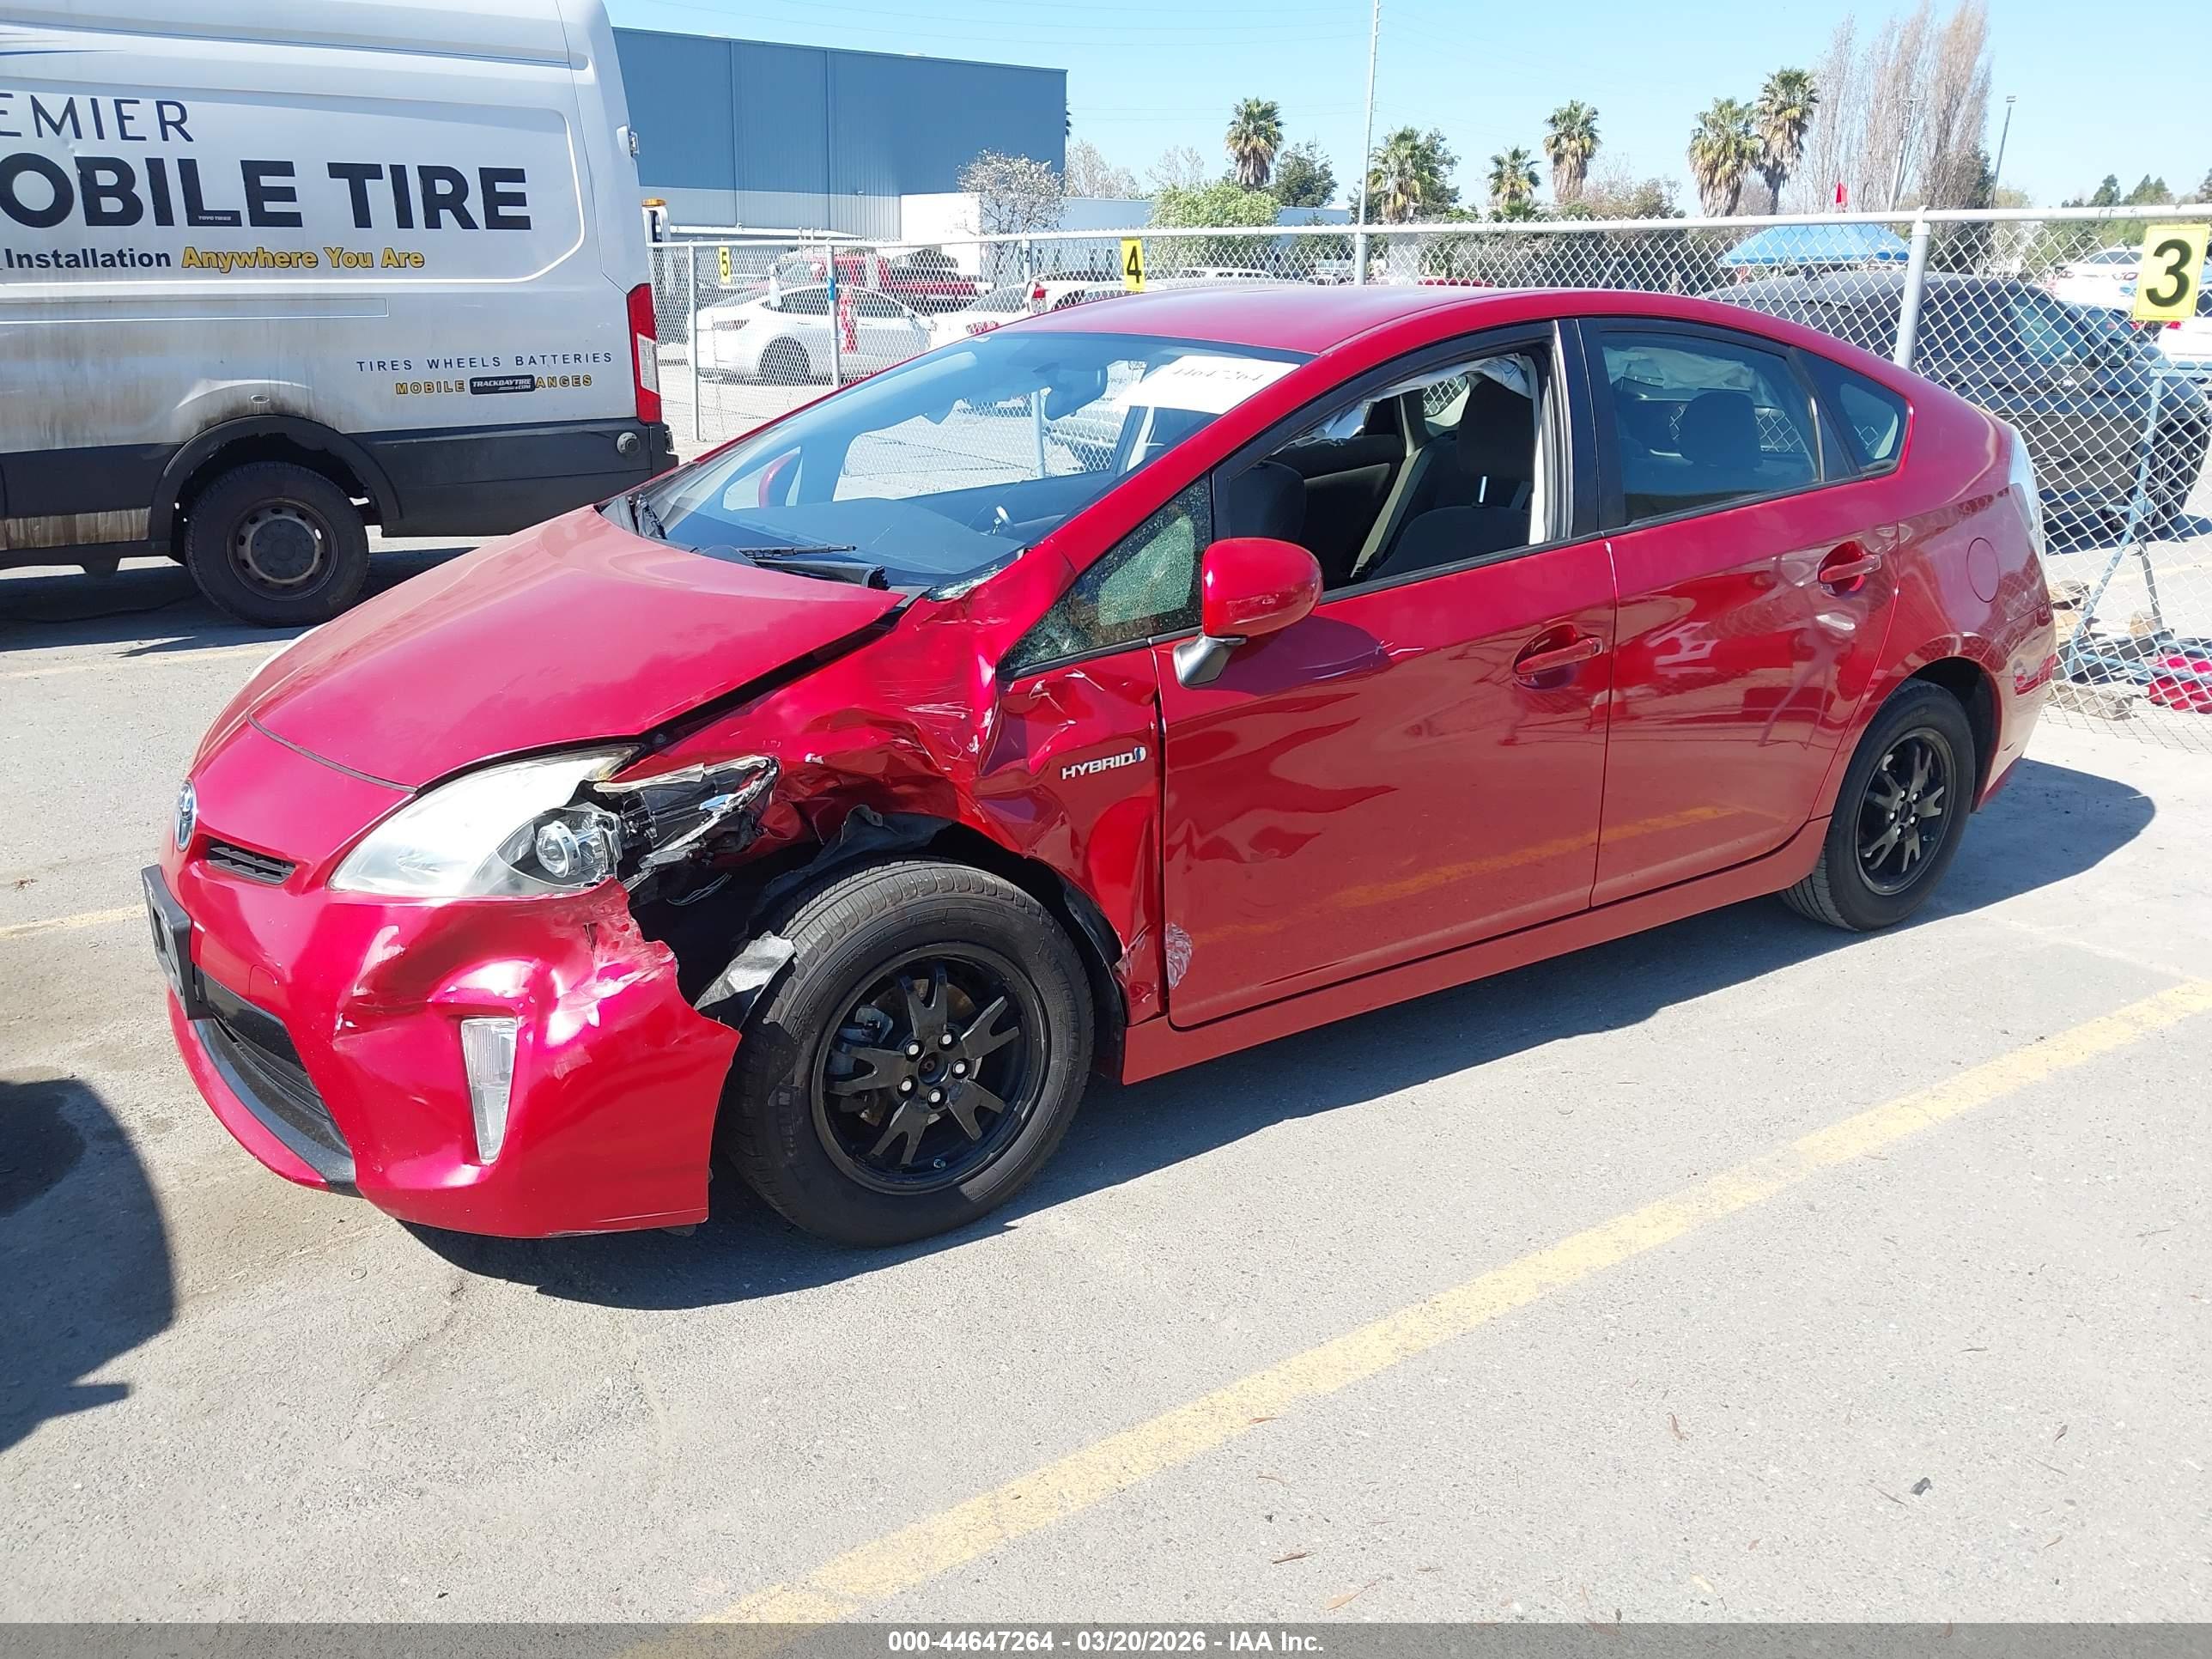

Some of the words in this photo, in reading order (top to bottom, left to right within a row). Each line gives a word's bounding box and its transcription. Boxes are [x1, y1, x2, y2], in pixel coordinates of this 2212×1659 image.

[0, 152, 302, 228] OBILE
[327, 161, 532, 230] TIRE
[4, 248, 171, 269] Installation
[181, 246, 318, 273] Anywhere
[323, 247, 374, 268] You
[380, 247, 424, 268] Are
[721, 252, 728, 276] 5
[1126, 246, 1142, 283] 4
[2146, 239, 2192, 307] 3
[357, 360, 412, 372] TIRES
[427, 356, 501, 369] WHEELS
[515, 352, 613, 366] BATTERIES
[395, 380, 465, 394] MOBILE
[535, 374, 592, 389] ANGES
[472, 378, 532, 387] TRACKDAYTIRE
[1061, 752, 1135, 780] HYBRID
